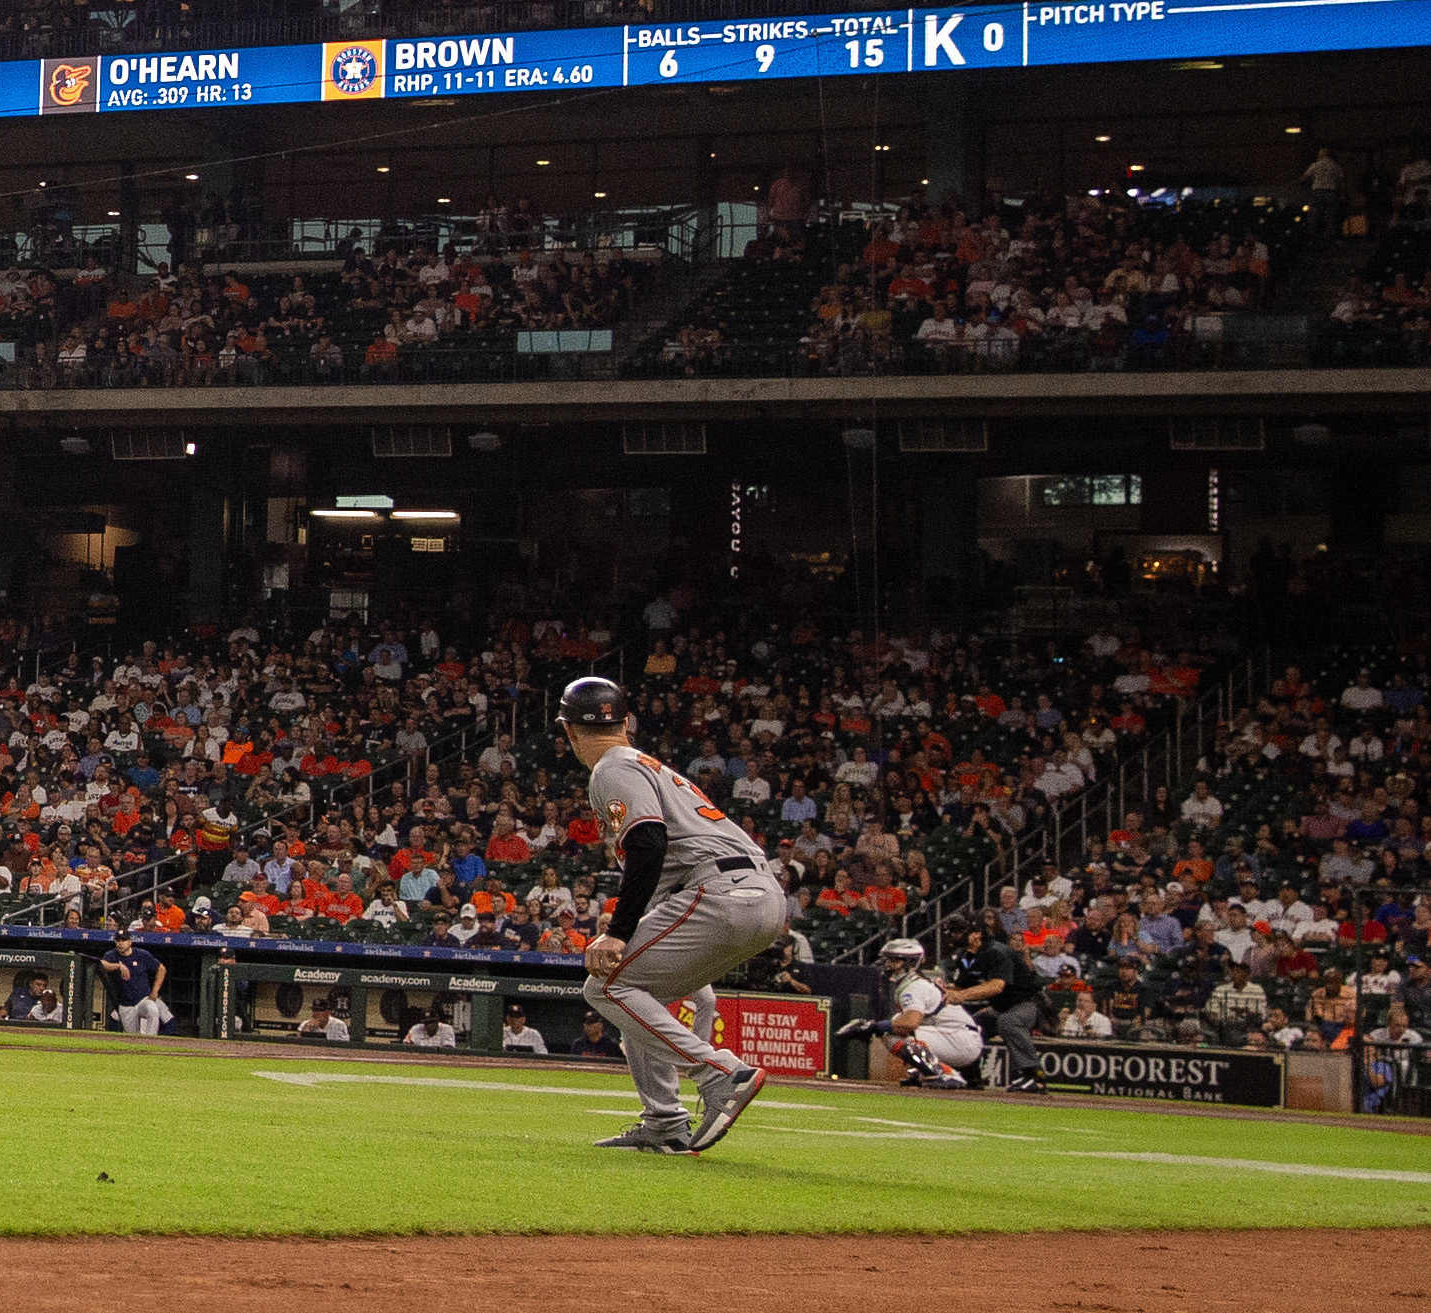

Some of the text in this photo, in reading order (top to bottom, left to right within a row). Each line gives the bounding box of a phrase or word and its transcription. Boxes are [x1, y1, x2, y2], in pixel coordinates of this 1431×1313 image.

[1040, 0, 1165, 26] PITCH TYPE
[638, 16, 898, 48] BALLS STRIKES TOTAL
[924, 13, 1004, 67] K 0
[395, 37, 514, 70] BROWN
[659, 38, 884, 78] 6 9 15
[108, 52, 240, 86] O'HEARN
[394, 65, 593, 95] RHP, 11-11 ERA: 4.60
[107, 83, 252, 107] AVG: .309 HR: 13
[293, 968, 342, 984] Academy
[360, 973, 431, 987] academy.com
[449, 977, 498, 991] Academy
[741, 1011, 798, 1027] THE STAY
[742, 1025, 819, 1043] IN YOUR CAR
[742, 1040, 805, 1055] 10 MINUTE
[742, 1053, 760, 1066] OIL
[1039, 1051, 1224, 1086] OODFOREST
[1092, 1082, 1223, 1102] NATIONAL BANK
